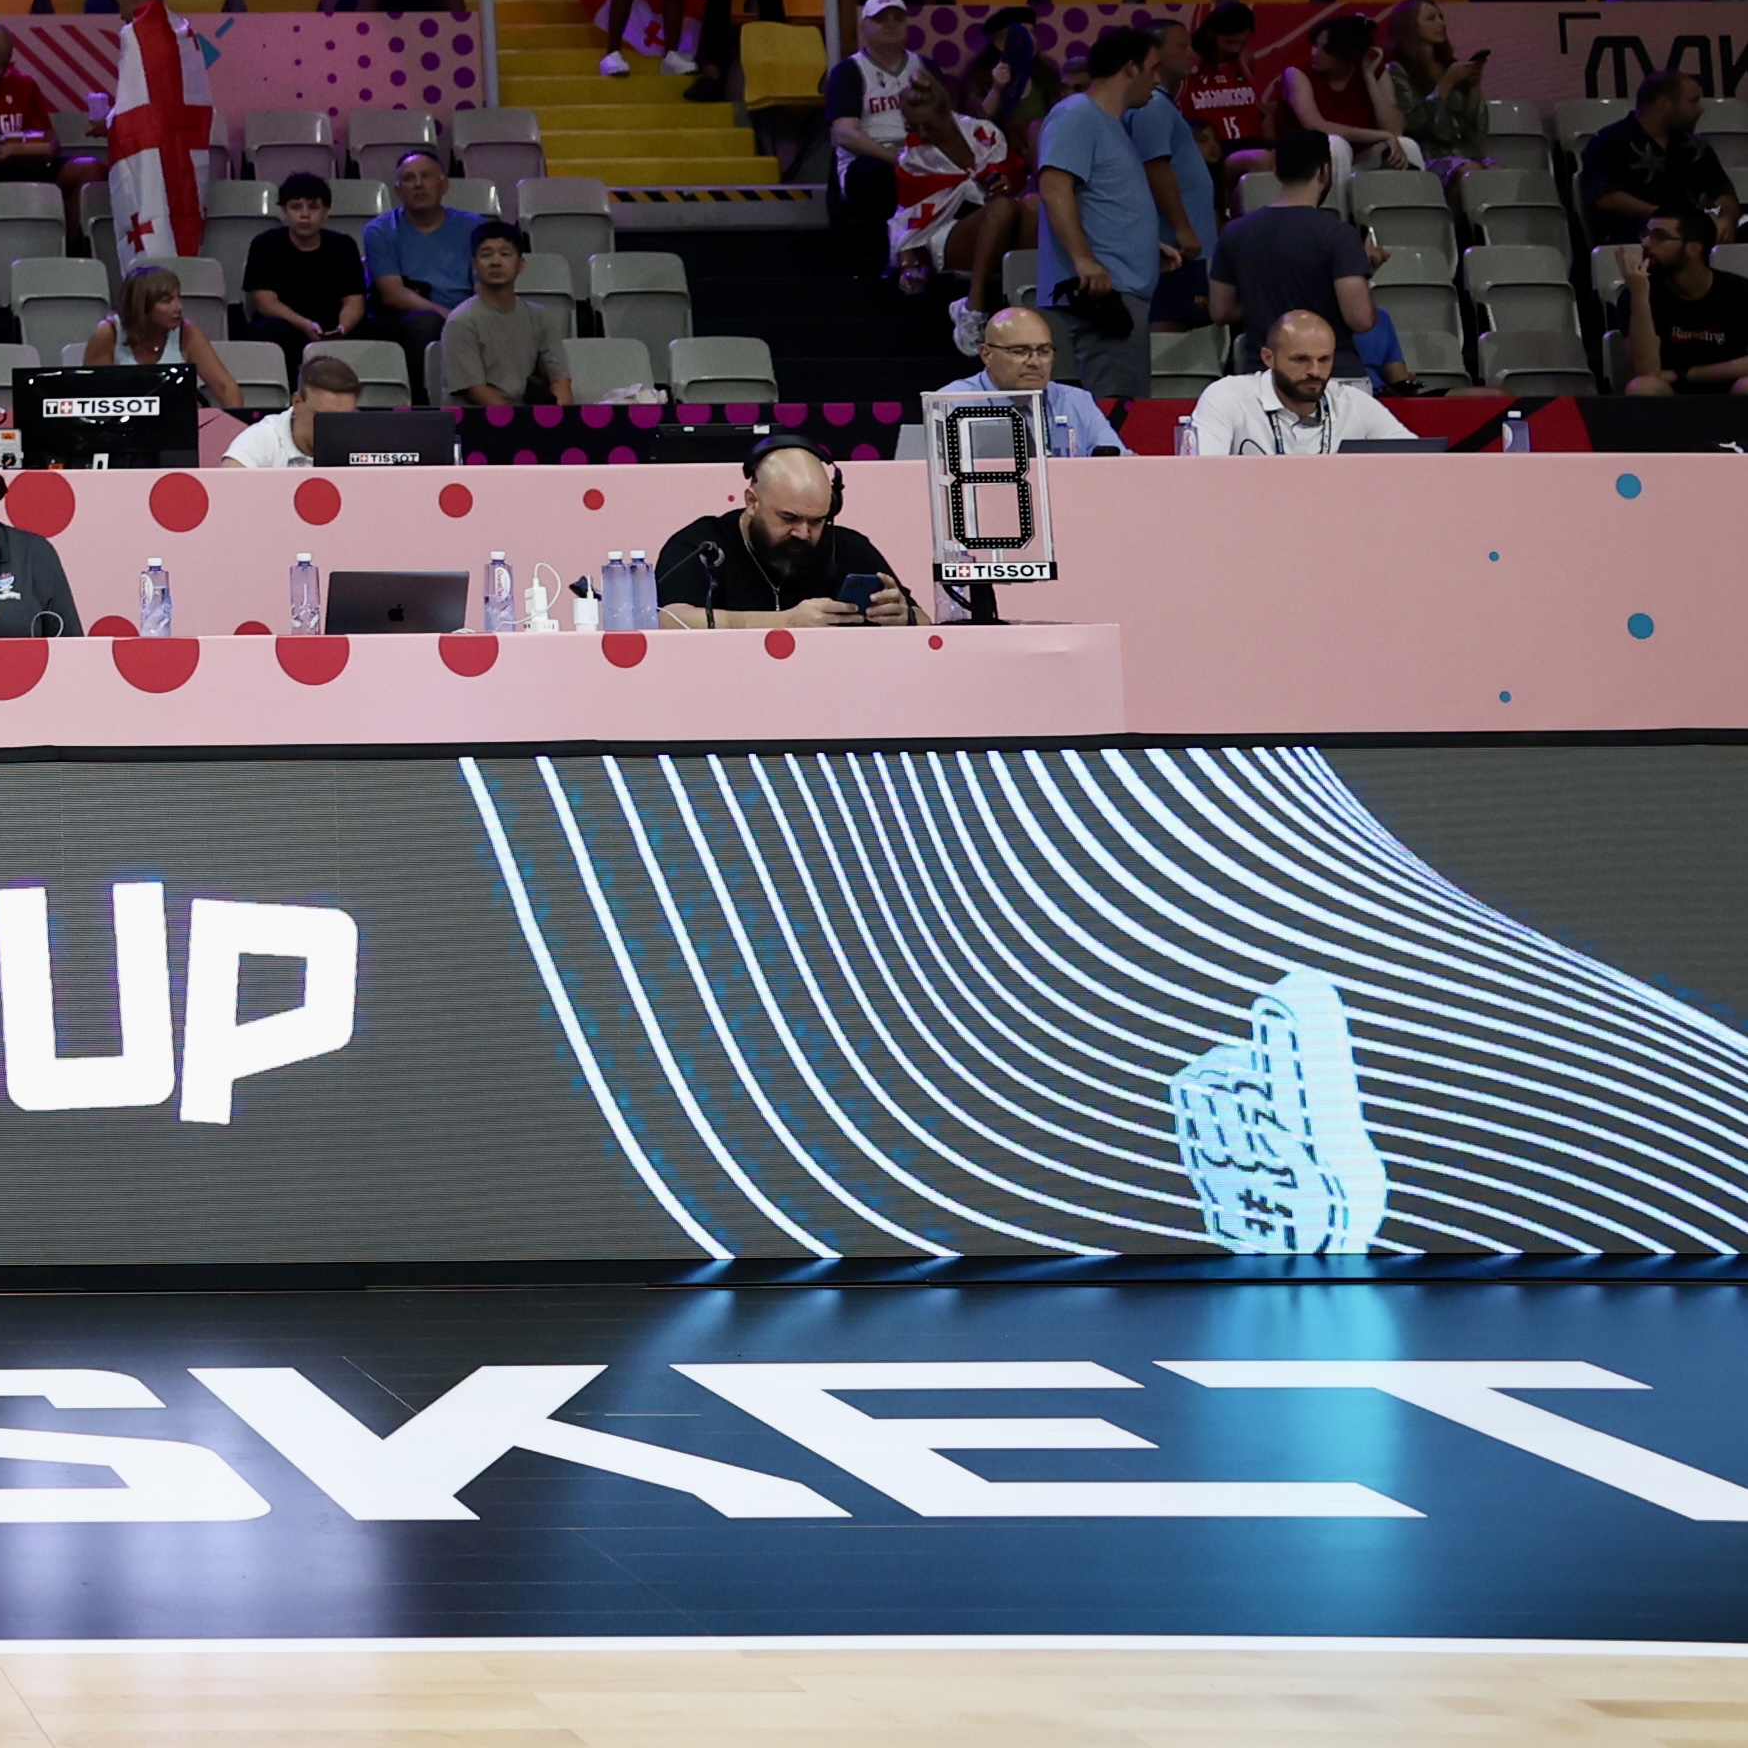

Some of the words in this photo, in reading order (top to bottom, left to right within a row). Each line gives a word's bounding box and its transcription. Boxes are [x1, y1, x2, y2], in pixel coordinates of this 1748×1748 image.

[1222, 116, 1241, 140] 15
[78, 398, 158, 415] TISSOT
[371, 454, 418, 463] TISSOT
[974, 564, 1047, 578] TISSOT
